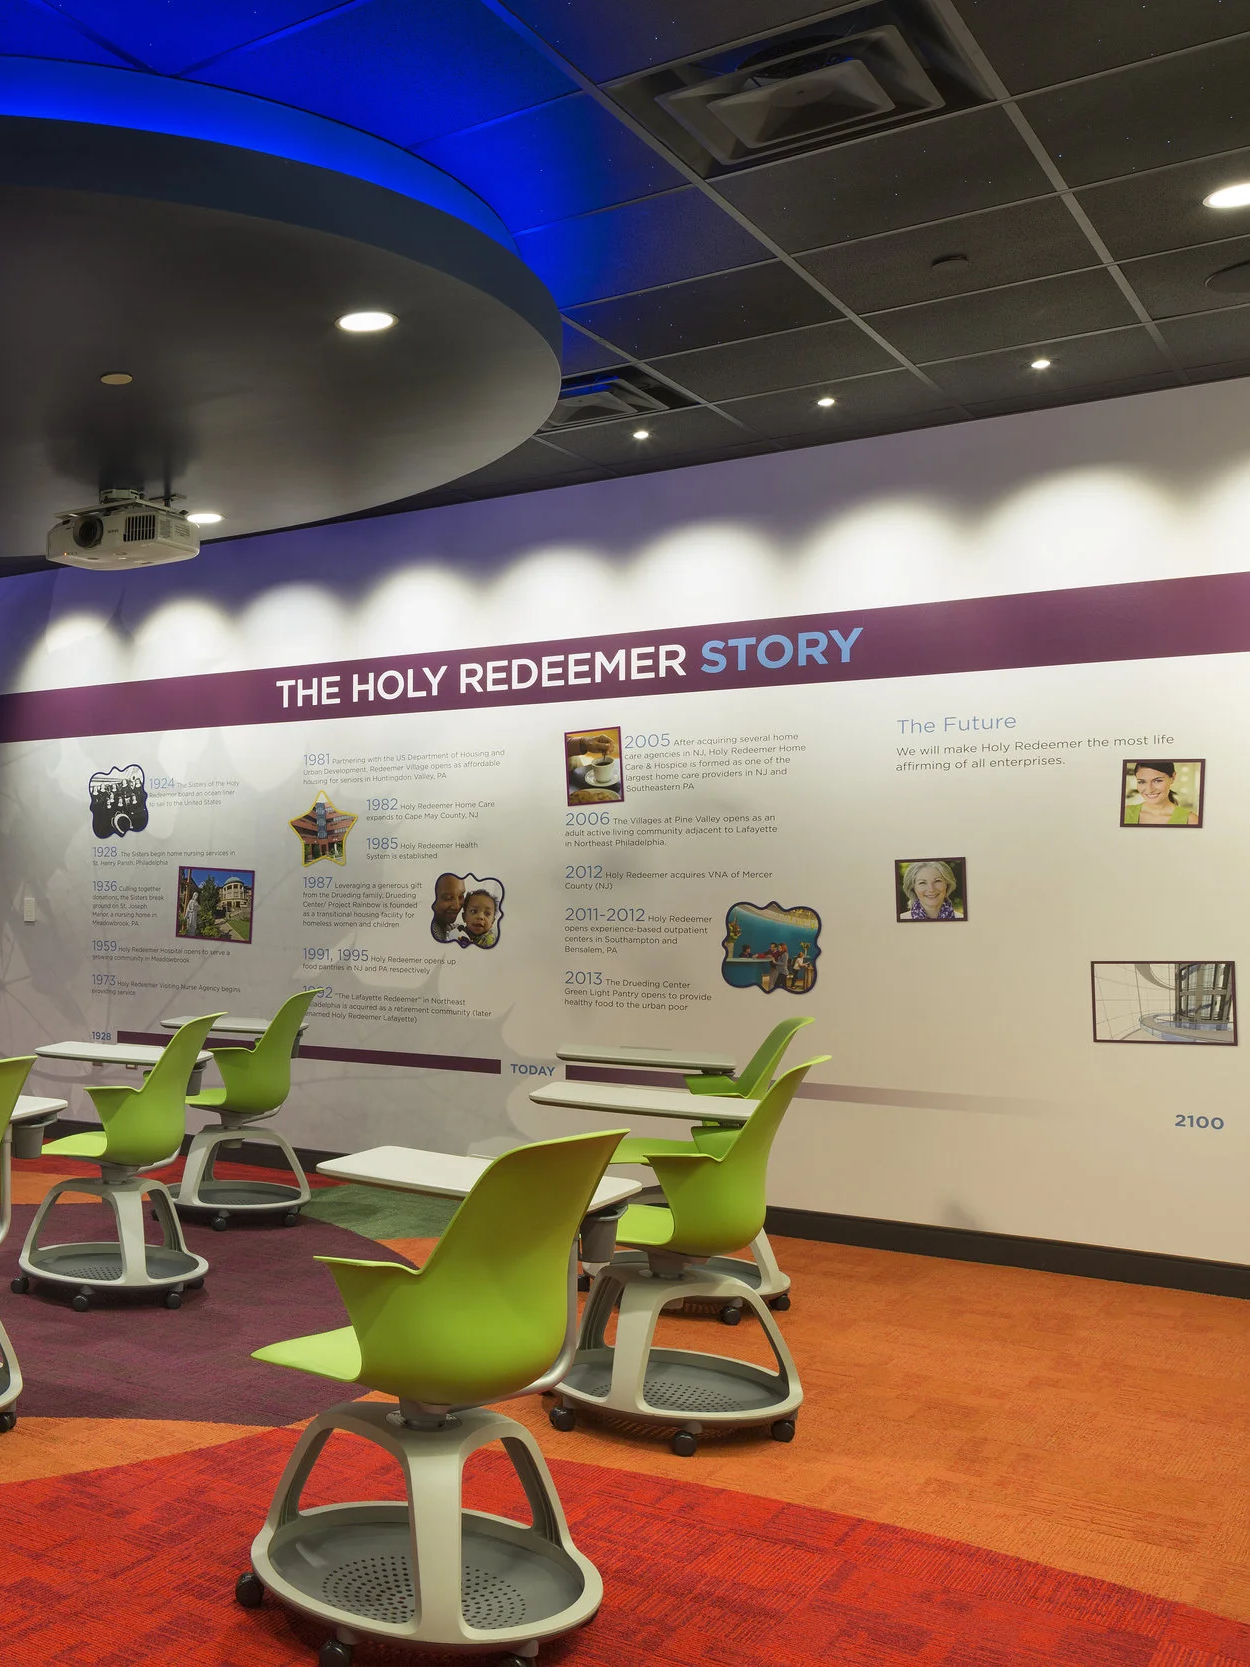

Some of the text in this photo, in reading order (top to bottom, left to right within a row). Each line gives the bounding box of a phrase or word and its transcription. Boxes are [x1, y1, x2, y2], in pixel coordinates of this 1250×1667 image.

[276, 628, 864, 708] THE HOLY REDEEMER STORY
[896, 716, 1016, 733] The Future
[625, 734, 670, 748] 2005
[696, 736, 737, 746] acquiring
[896, 734, 1174, 755] We will make Holy Redeemer the most life
[304, 754, 330, 765] 1981
[643, 751, 680, 760] agencies
[708, 748, 728, 756] Holy
[654, 761, 687, 770] Hospice
[895, 758, 950, 772] affirming
[954, 759, 967, 768] of
[971, 758, 984, 768] all
[701, 770, 742, 779] providers
[150, 778, 174, 789] 1924
[367, 798, 398, 810] 1982
[366, 813, 394, 822] expands
[566, 812, 610, 826] 2006
[636, 827, 682, 836] community
[367, 838, 398, 849] 1985
[93, 847, 117, 857] 1928
[565, 865, 603, 879] 2012
[670, 871, 705, 879] acquires
[93, 880, 118, 892] 1936
[303, 877, 332, 888] 1987
[565, 908, 645, 922] 2011-2012
[590, 925, 661, 934] experience-based
[663, 926, 707, 935] outpatient
[92, 940, 117, 951] 1959
[303, 948, 333, 962] 1991,
[338, 949, 369, 961] 1995
[92, 974, 116, 986] 1973
[565, 971, 602, 985] 2013
[622, 979, 660, 988] Drueding
[589, 989, 610, 997] Light
[612, 989, 639, 998] Pantry
[679, 992, 711, 1001] provide
[564, 998, 592, 1007] healthy
[92, 1031, 111, 1040] 1928
[511, 1064, 555, 1076] TODAY
[1174, 1114, 1225, 1131] 2100
